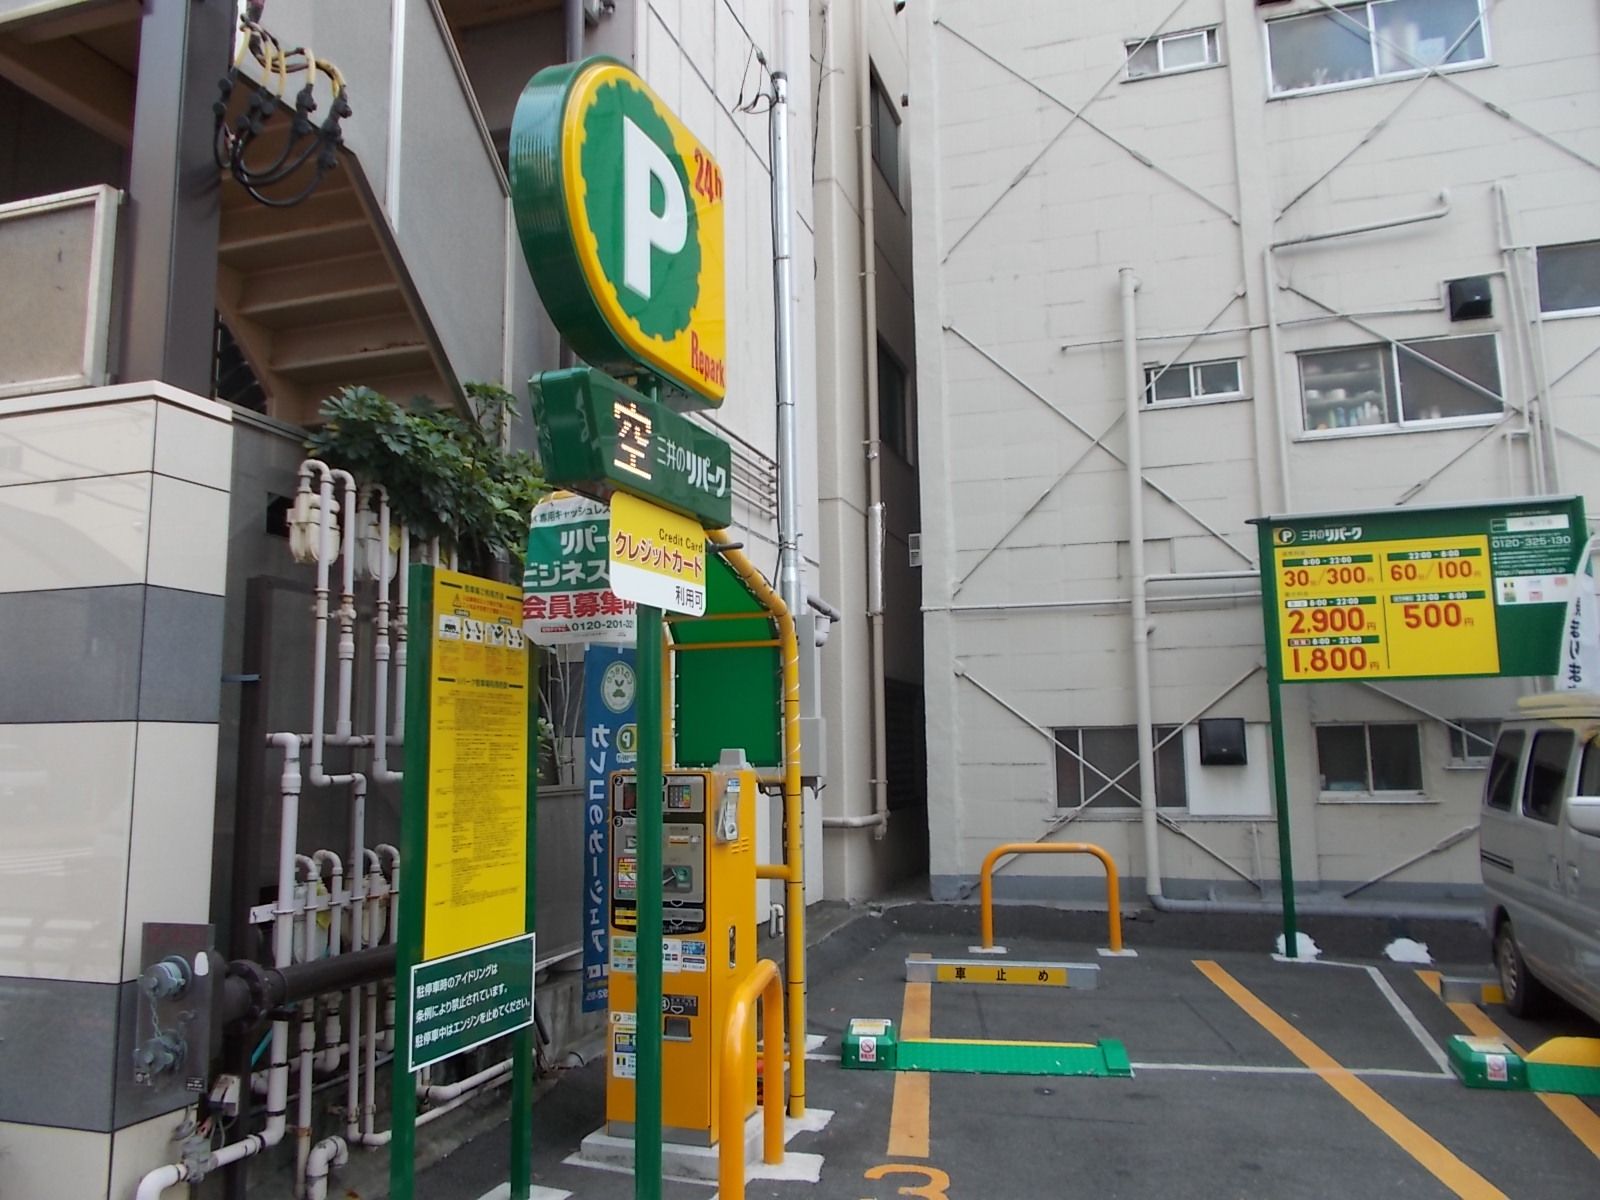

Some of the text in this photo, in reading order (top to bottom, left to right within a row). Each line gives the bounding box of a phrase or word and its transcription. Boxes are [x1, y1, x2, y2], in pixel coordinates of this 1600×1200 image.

[694, 148, 723, 204] 24h
[624, 116, 688, 301] P
[691, 331, 726, 388] Repark
[614, 402, 652, 480] 空
[657, 436, 726, 498] 三井のリパーク
[560, 524, 611, 556] リパー
[614, 531, 703, 578] クレジットカード
[659, 528, 704, 553] Credit Card
[1301, 527, 1362, 542] 三井のリパーク
[675, 585, 703, 611] 利用可
[571, 619, 633, 632] 0120-201-32
[416, 963, 498, 999] 駐停車時のアイドリングは
[415, 983, 508, 1024] 条例により禁止されています。
[415, 997, 531, 1049] 駐停車中はエンジンを止めてください。
